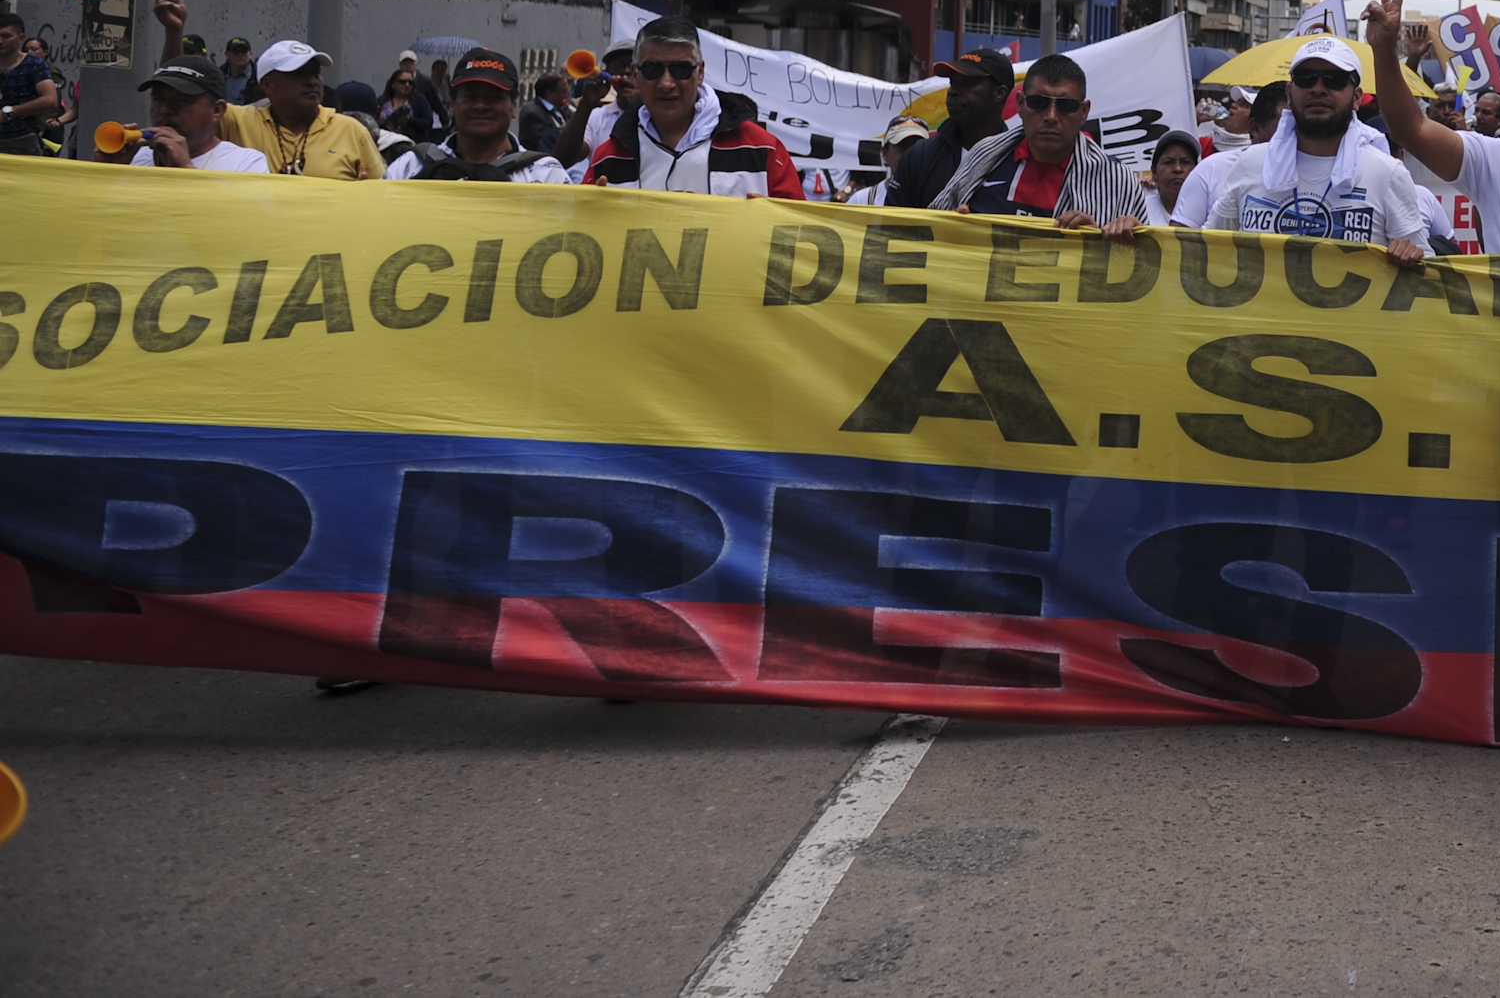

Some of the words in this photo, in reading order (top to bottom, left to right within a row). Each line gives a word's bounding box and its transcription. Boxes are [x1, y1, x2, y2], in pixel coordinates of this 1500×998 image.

[724, 49, 766, 95] DE
[1245, 210, 1273, 230] OXG
[1345, 211, 1370, 229] RED
[763, 224, 935, 307] DE
